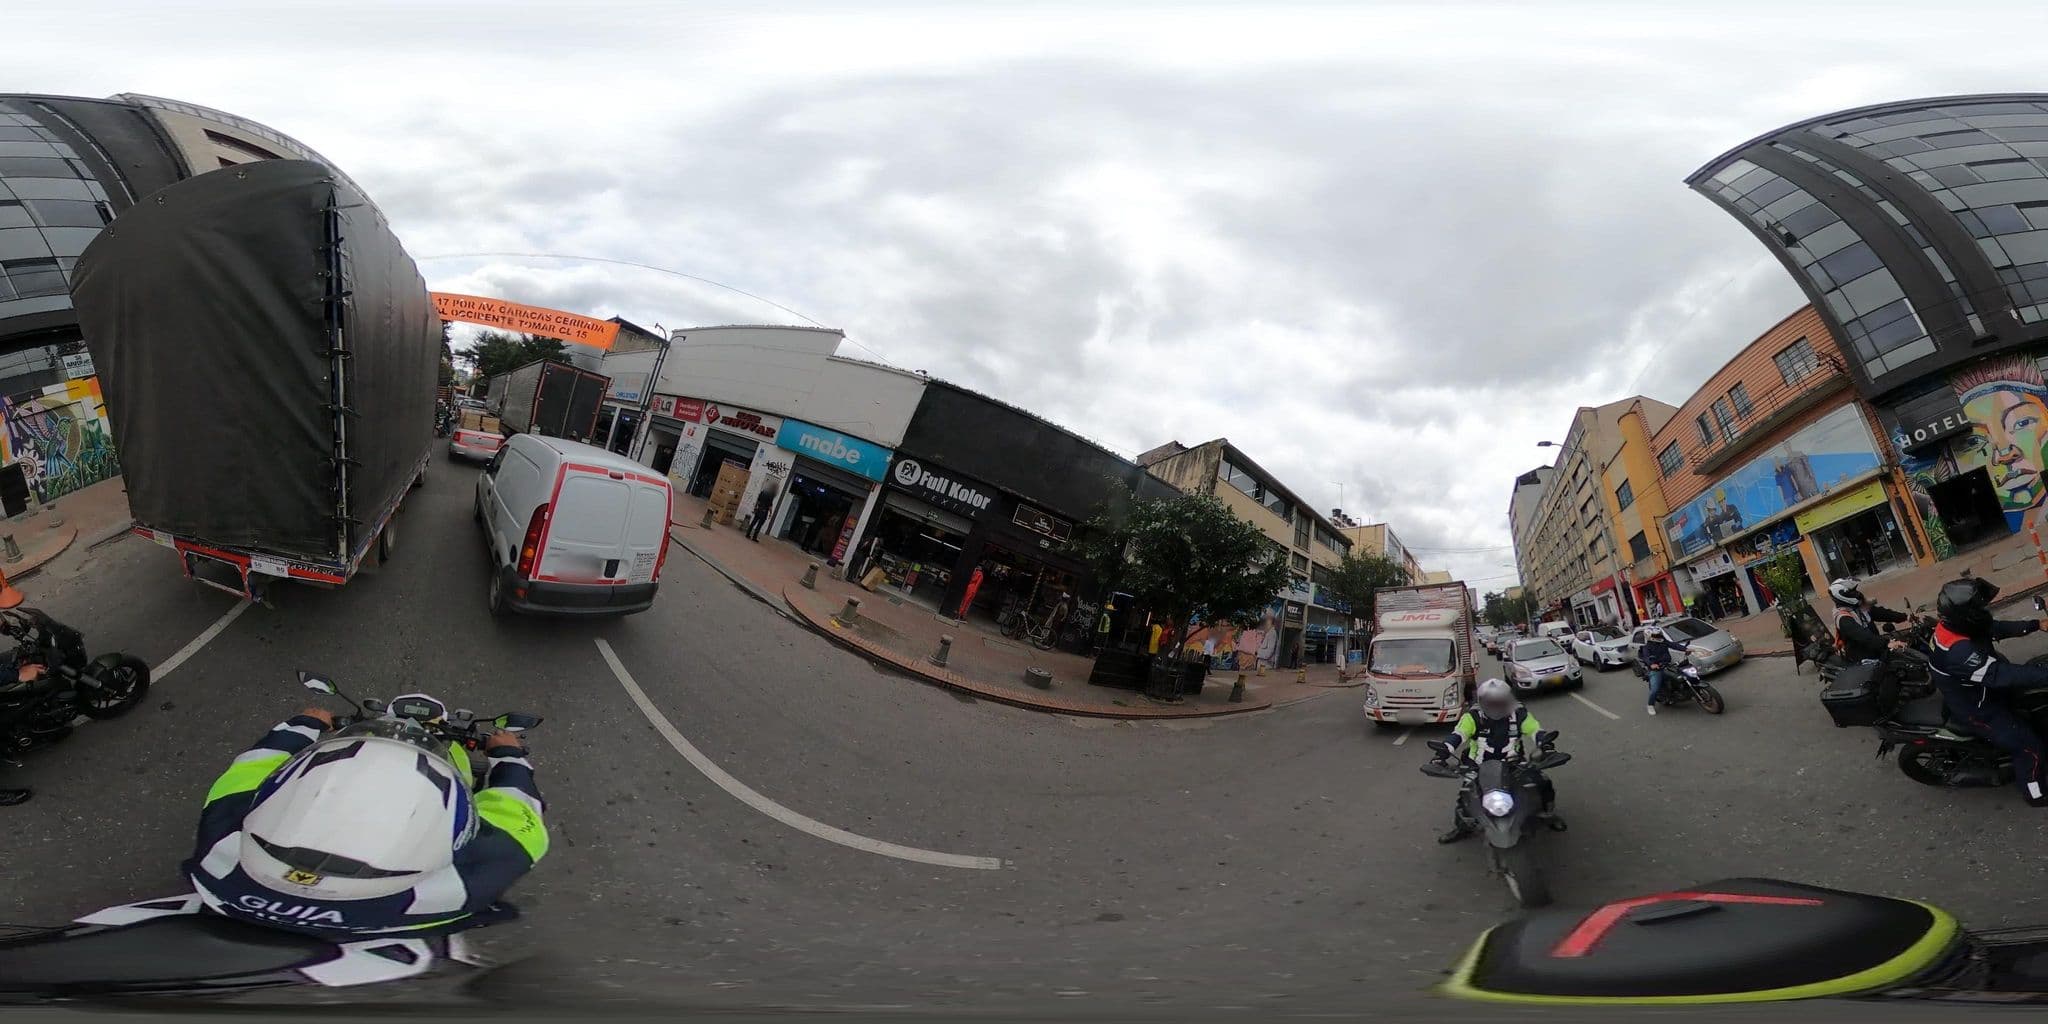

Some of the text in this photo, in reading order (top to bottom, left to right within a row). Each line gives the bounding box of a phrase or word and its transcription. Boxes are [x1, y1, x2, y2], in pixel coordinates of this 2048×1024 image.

[438, 297, 604, 333] 17 POR AV. CARACAS CERRADA
[451, 309, 514, 325] OCCIDENTE
[519, 319, 556, 333] TOMAR
[559, 326, 571, 336] CL
[576, 330, 587, 339] 15
[1900, 413, 1969, 448] HOTEL
[799, 433, 860, 464] mabe
[919, 470, 950, 494] Full
[948, 481, 991, 510] Kolor
[1391, 613, 1441, 622] JMC
[240, 895, 344, 923] GUIA
